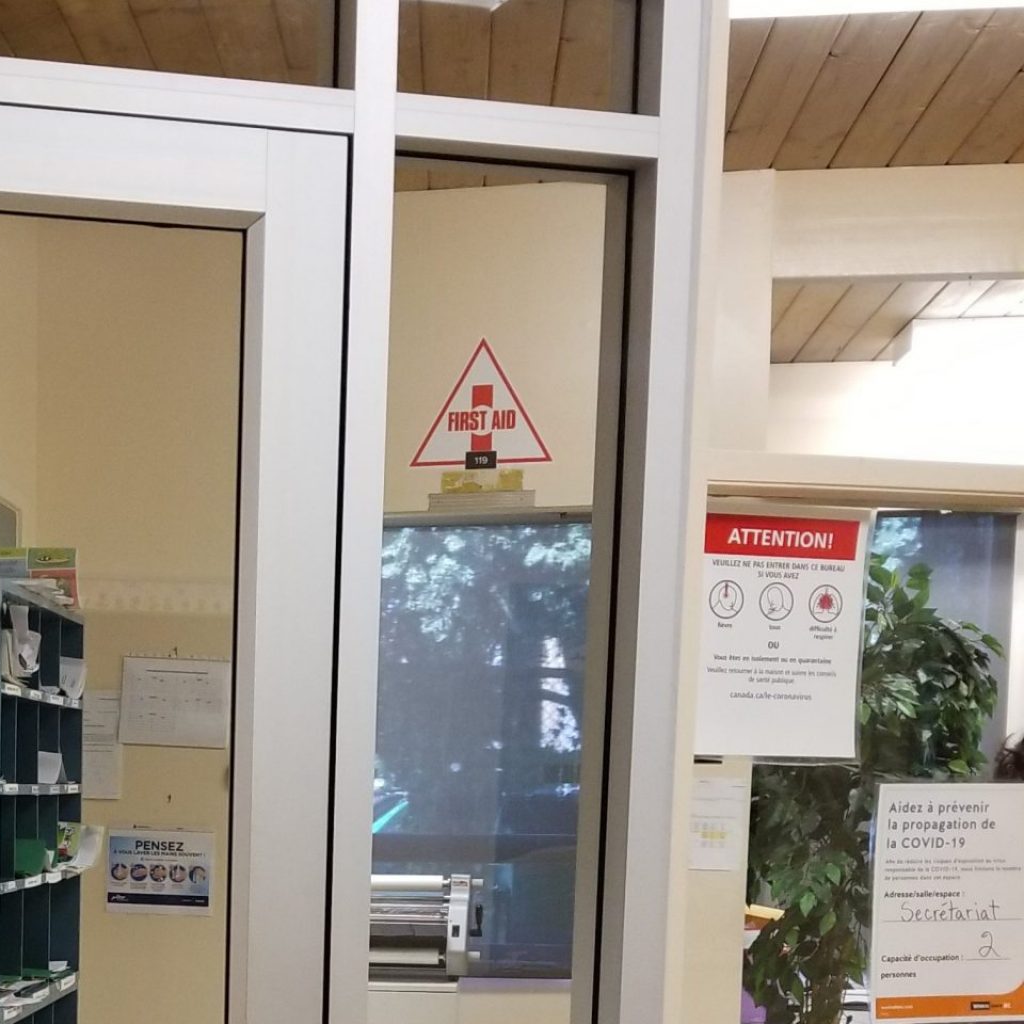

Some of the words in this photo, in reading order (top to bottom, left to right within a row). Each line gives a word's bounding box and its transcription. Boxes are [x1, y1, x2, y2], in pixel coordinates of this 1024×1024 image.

[448, 411, 487, 432] FIRST
[491, 410, 516, 430] AID
[727, 528, 833, 549] ATTENTION!
[712, 559, 741, 568] VEUILLEZ
[742, 560, 751, 568] NE
[753, 561, 764, 569] PAS
[766, 561, 790, 570] ENTRER
[792, 562, 809, 571] DANS
[811, 563, 819, 571] CE
[820, 563, 845, 572] BUREAU
[765, 571, 782, 579] VOUS
[767, 641, 780, 649] OU
[888, 801, 923, 814] Aidez
[927, 801, 934, 814] à
[937, 801, 990, 816] prévenir
[887, 818, 898, 830] la
[902, 818, 978, 834] propagation
[981, 818, 996, 830] de
[135, 840, 184, 851] PENSEZ
[886, 837, 897, 849] la
[901, 836, 966, 849] COVID-19
[884, 890, 961, 899] Adresse/salle/espace
[900, 899, 1001, 922] Secrétariat
[978, 930, 1001, 958] 2
[881, 954, 912, 964] Capacité
[913, 953, 960, 964] d'occupation
[880, 970, 917, 980] personnes
